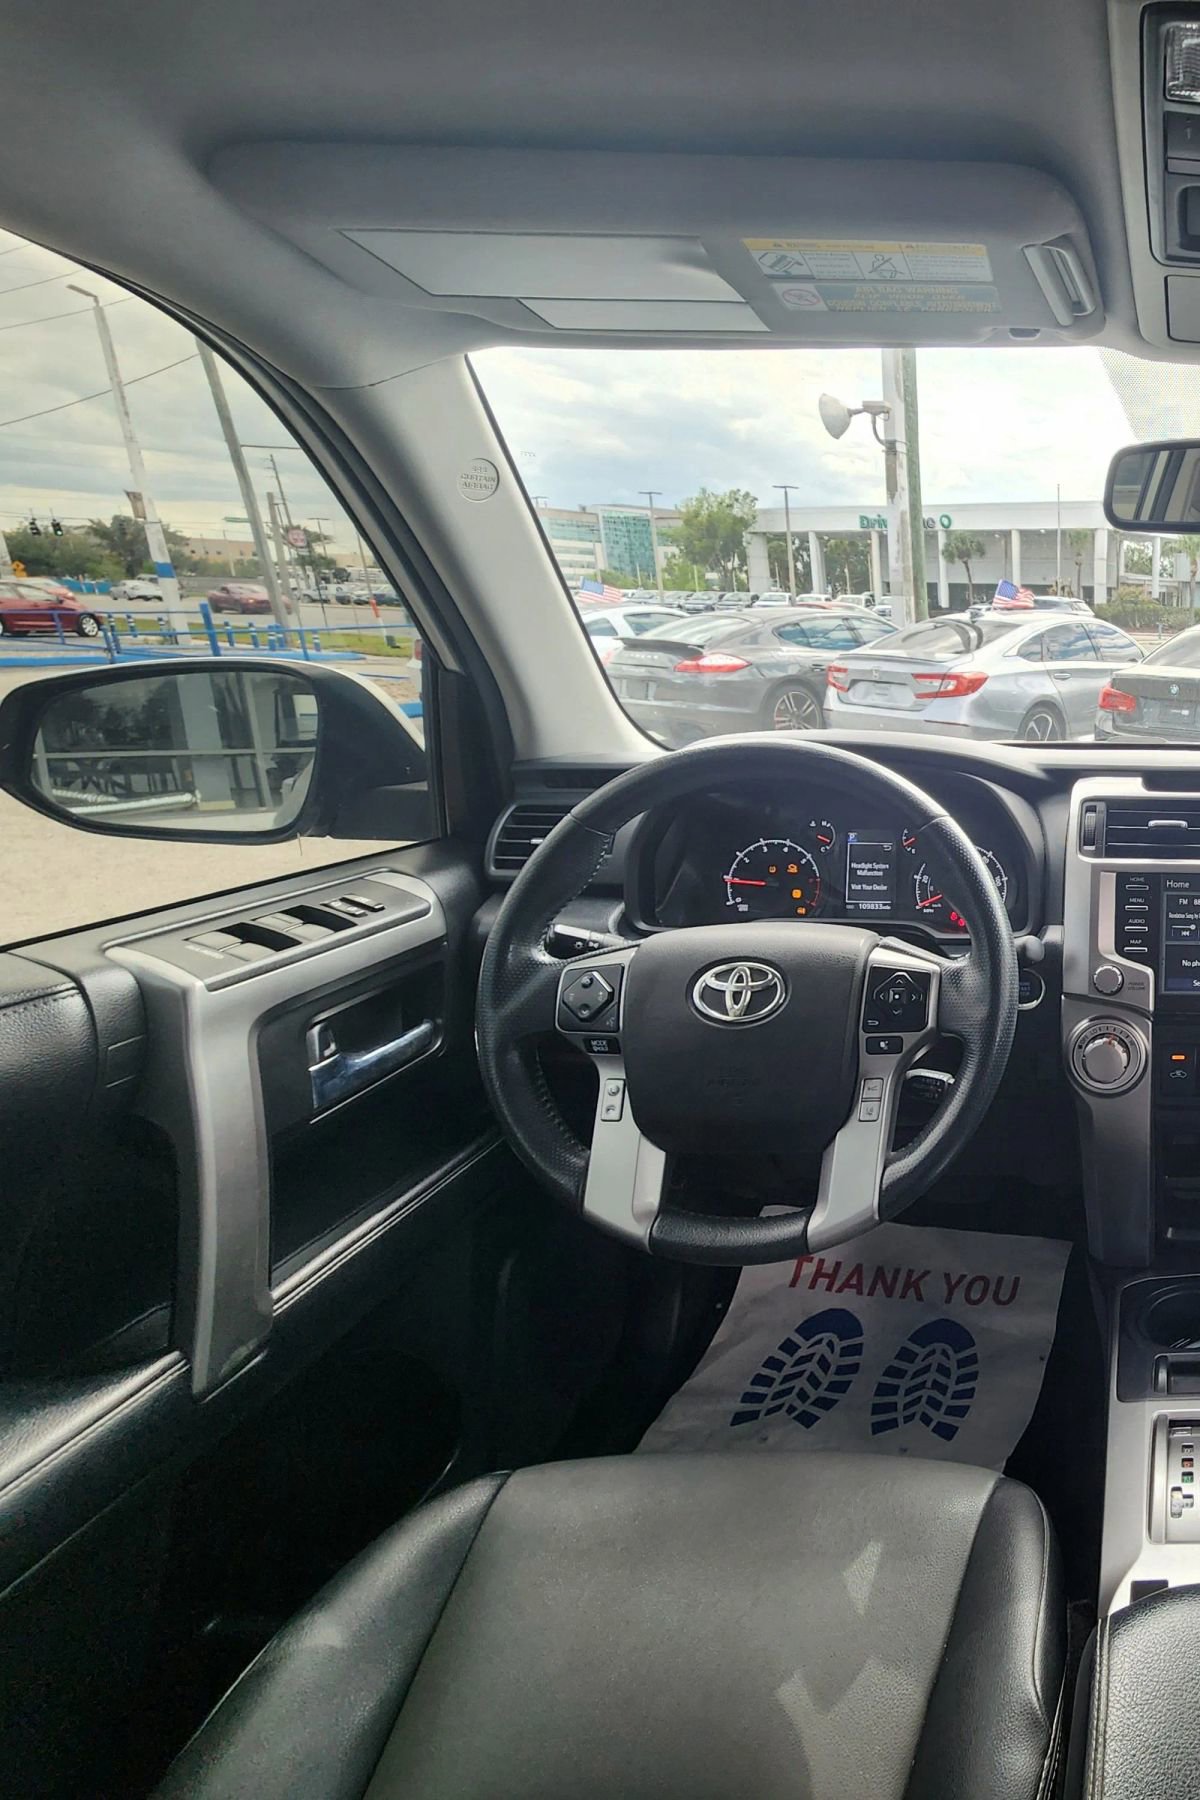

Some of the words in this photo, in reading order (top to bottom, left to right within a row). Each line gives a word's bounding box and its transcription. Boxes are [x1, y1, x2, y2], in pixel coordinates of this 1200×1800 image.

[1184, 128, 1191, 140] 1
[1166, 880, 1190, 889] Home
[788, 1254, 931, 1302] THANK
[943, 1271, 1021, 1307] YOU
